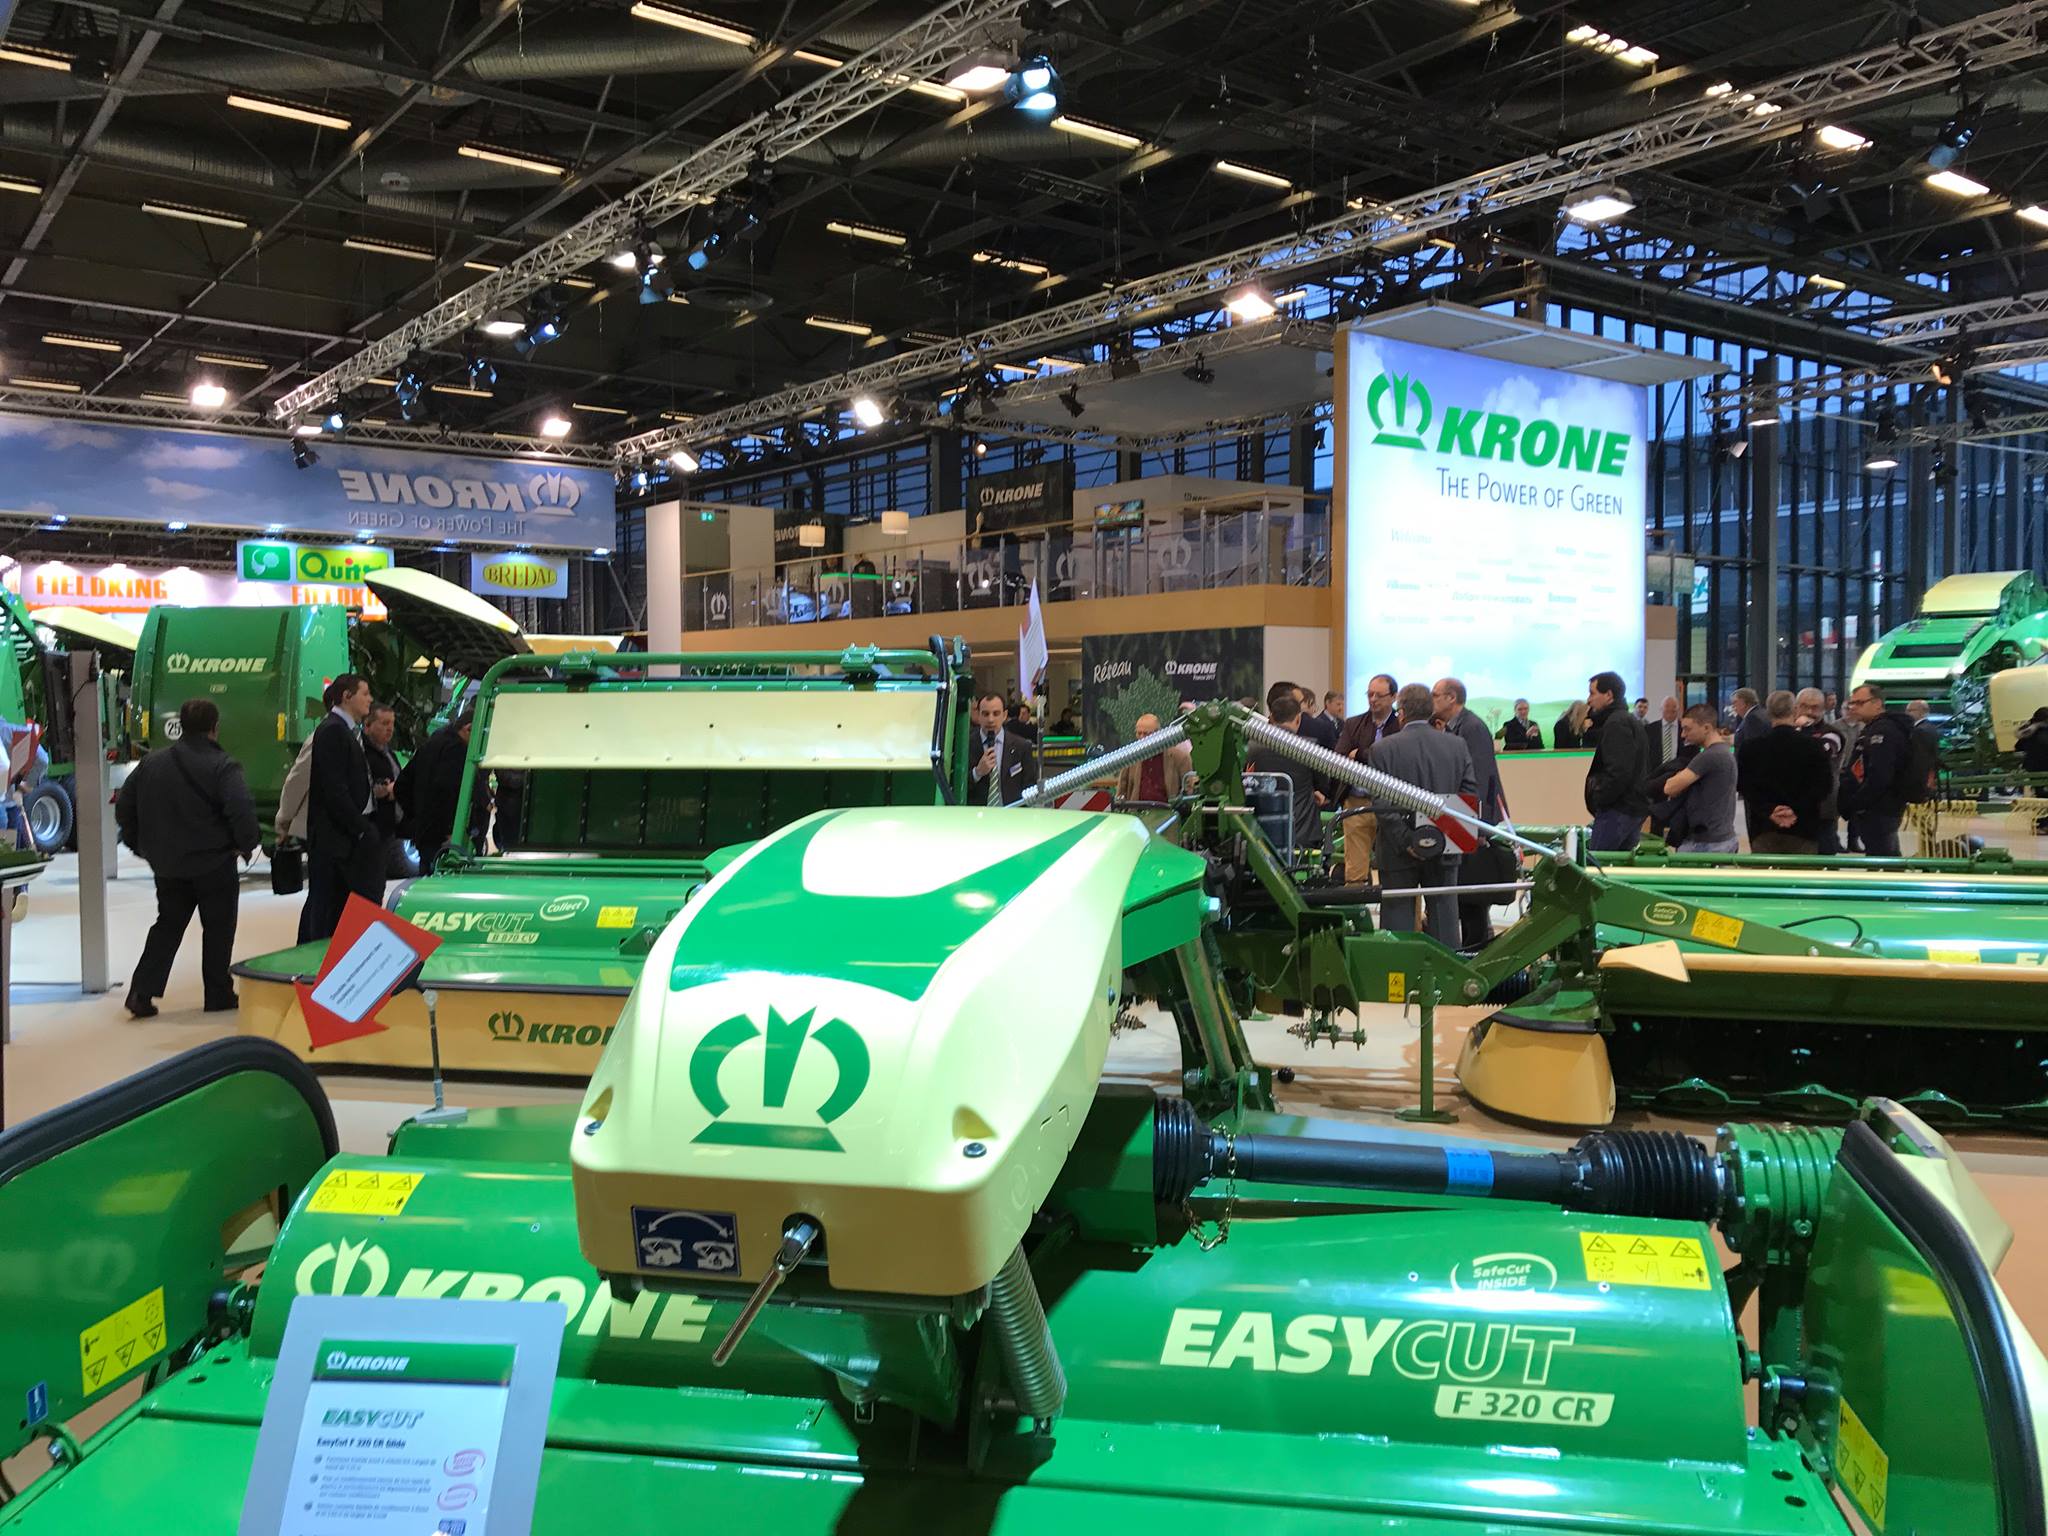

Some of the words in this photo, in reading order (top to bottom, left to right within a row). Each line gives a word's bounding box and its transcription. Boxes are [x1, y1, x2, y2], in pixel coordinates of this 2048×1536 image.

[1436, 406, 1631, 476] KRONE
[994, 482, 1044, 504] KRONE
[1436, 467, 1469, 498] THE
[1478, 473, 1537, 506] POWER
[1570, 485, 1623, 515] GREEN
[36, 575, 168, 600] FIELDKING
[487, 565, 558, 590] BREDAL
[188, 657, 267, 673] KRONE
[1093, 660, 1132, 684] Réseau
[1177, 662, 1218, 675] KRONE
[547, 901, 583, 913] Collect
[410, 911, 534, 935] EASYCUT
[1473, 1263, 1531, 1279] SafeCut
[1477, 1275, 1527, 1290] INSIDE
[1160, 1308, 1576, 1386] EASYCUT
[345, 1356, 410, 1371] KRONE
[1453, 1391, 1472, 1415] F
[1480, 1392, 1541, 1418] 320
[1552, 1397, 1597, 1422] CR
[321, 1408, 425, 1430] EASYCUT
